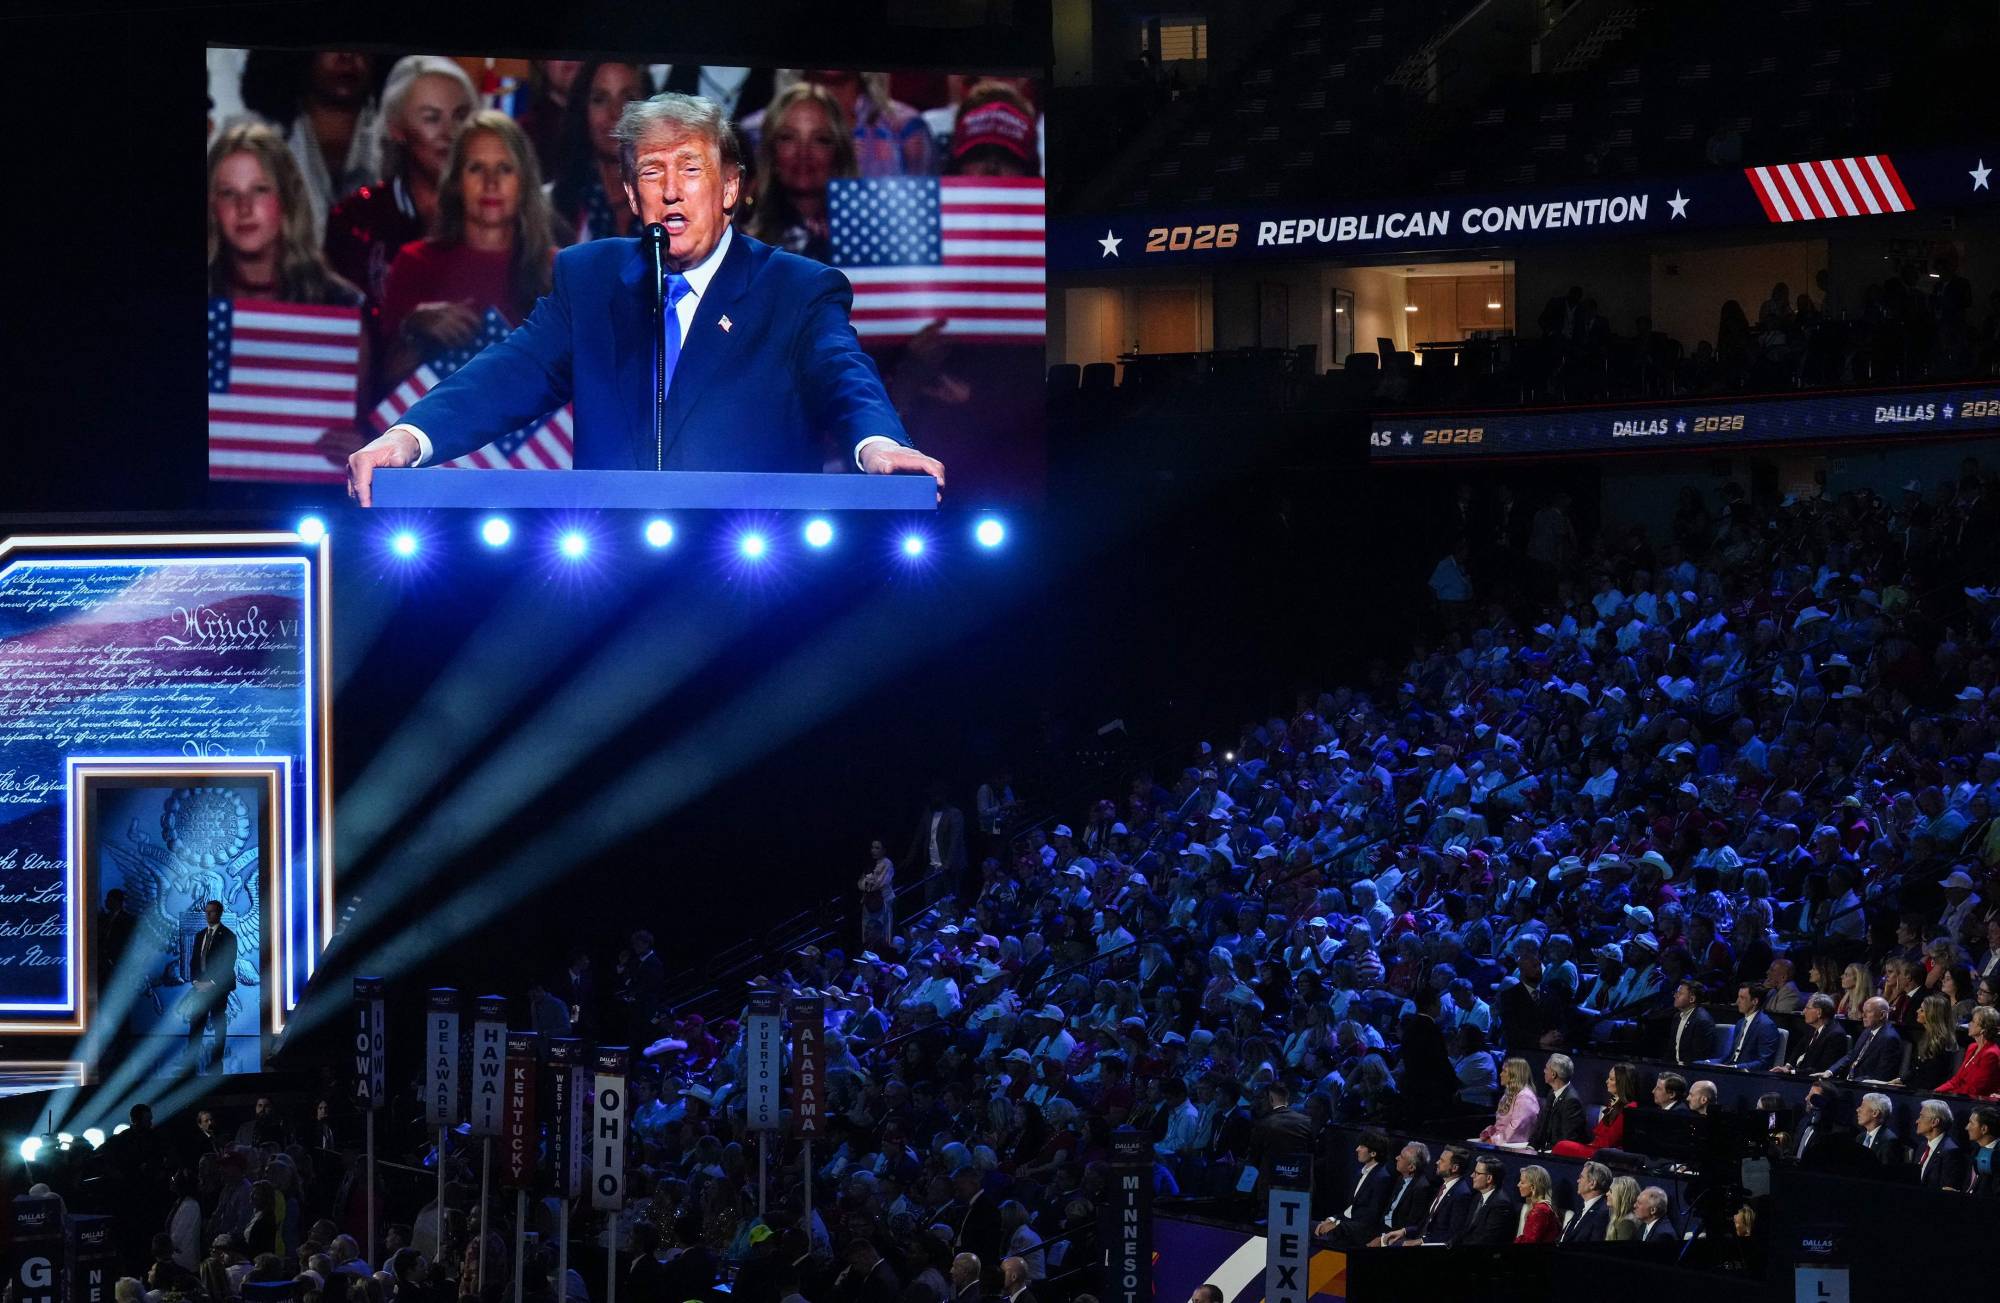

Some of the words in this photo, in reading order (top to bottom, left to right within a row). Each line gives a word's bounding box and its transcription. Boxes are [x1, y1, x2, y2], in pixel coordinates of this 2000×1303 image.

[1146, 223, 1240, 252] 2026
[1257, 210, 1450, 246] REPUBLICAN
[1461, 194, 1649, 234] CONVENTION
[1612, 418, 1669, 437] DALLAS
[1875, 403, 1936, 423] DALLAS
[1960, 400, 2000, 418] 202
[355, 1010, 370, 1098] IOWA
[374, 1010, 383, 1098] IOWA
[435, 1019, 450, 1118] DELAWARE
[480, 1029, 499, 1129] HAWAII
[759, 1022, 769, 1079] PUERTO
[801, 1028, 816, 1131] ALABAMA
[511, 1068, 526, 1178] KENTUCKY
[555, 1074, 564, 1110] WEST
[759, 1085, 768, 1122] RICO
[554, 1115, 563, 1189] VIRGINIA
[598, 1089, 620, 1196] OHIO
[1122, 1175, 1139, 1303] MINNESOT
[1802, 1239, 1833, 1247] DALLAS
[20, 1256, 53, 1303] G
